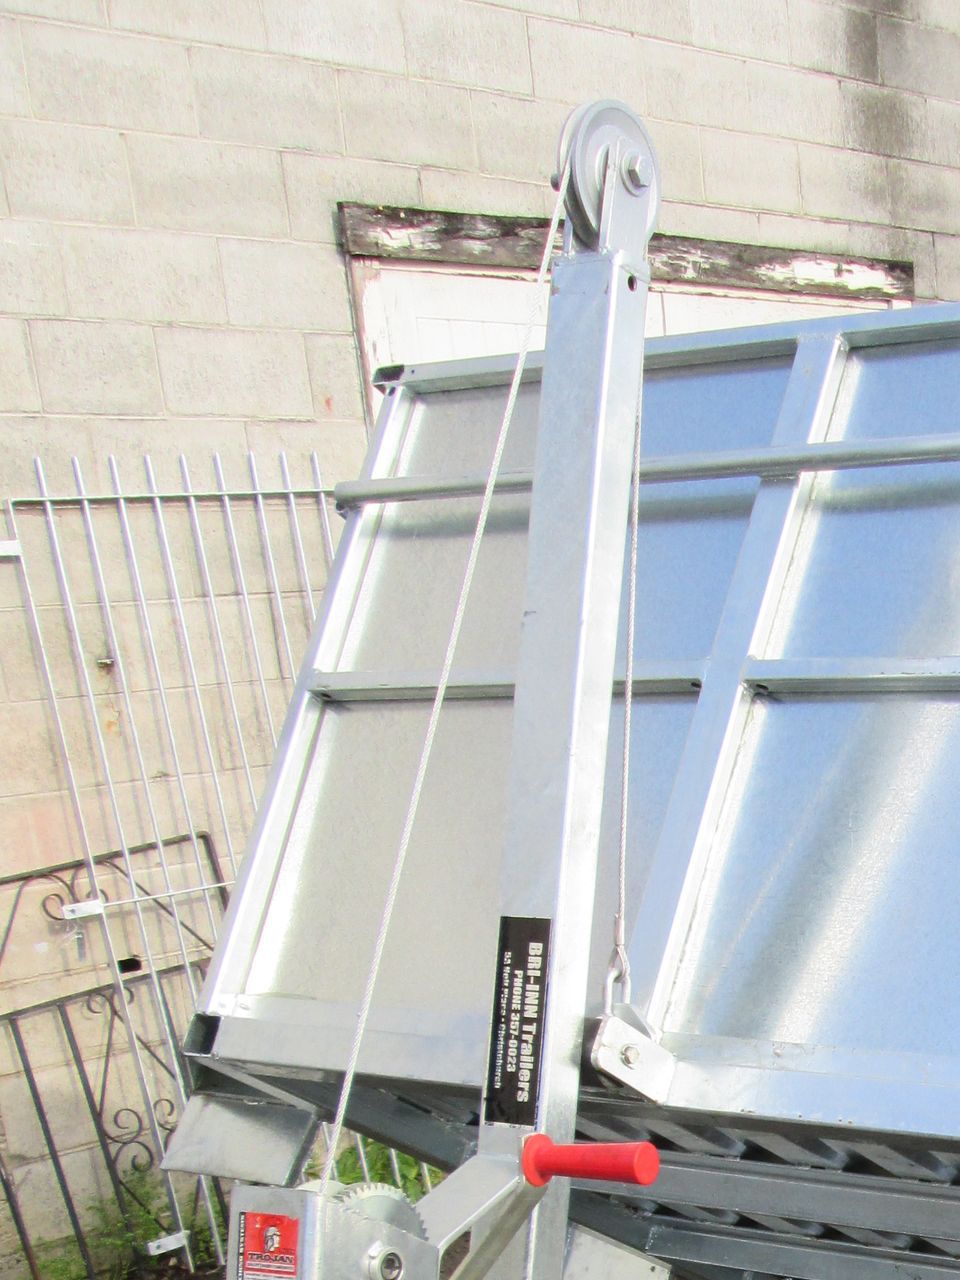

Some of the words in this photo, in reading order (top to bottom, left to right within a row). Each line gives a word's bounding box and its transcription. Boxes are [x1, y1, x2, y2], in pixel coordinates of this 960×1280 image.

[511, 970, 524, 1012] PHONE
[523, 942, 543, 1018] BRI-INN
[506, 1013, 521, 1073] 357-0023
[516, 1022, 537, 1103] Trailers
[248, 1252, 294, 1264] TROJAN
